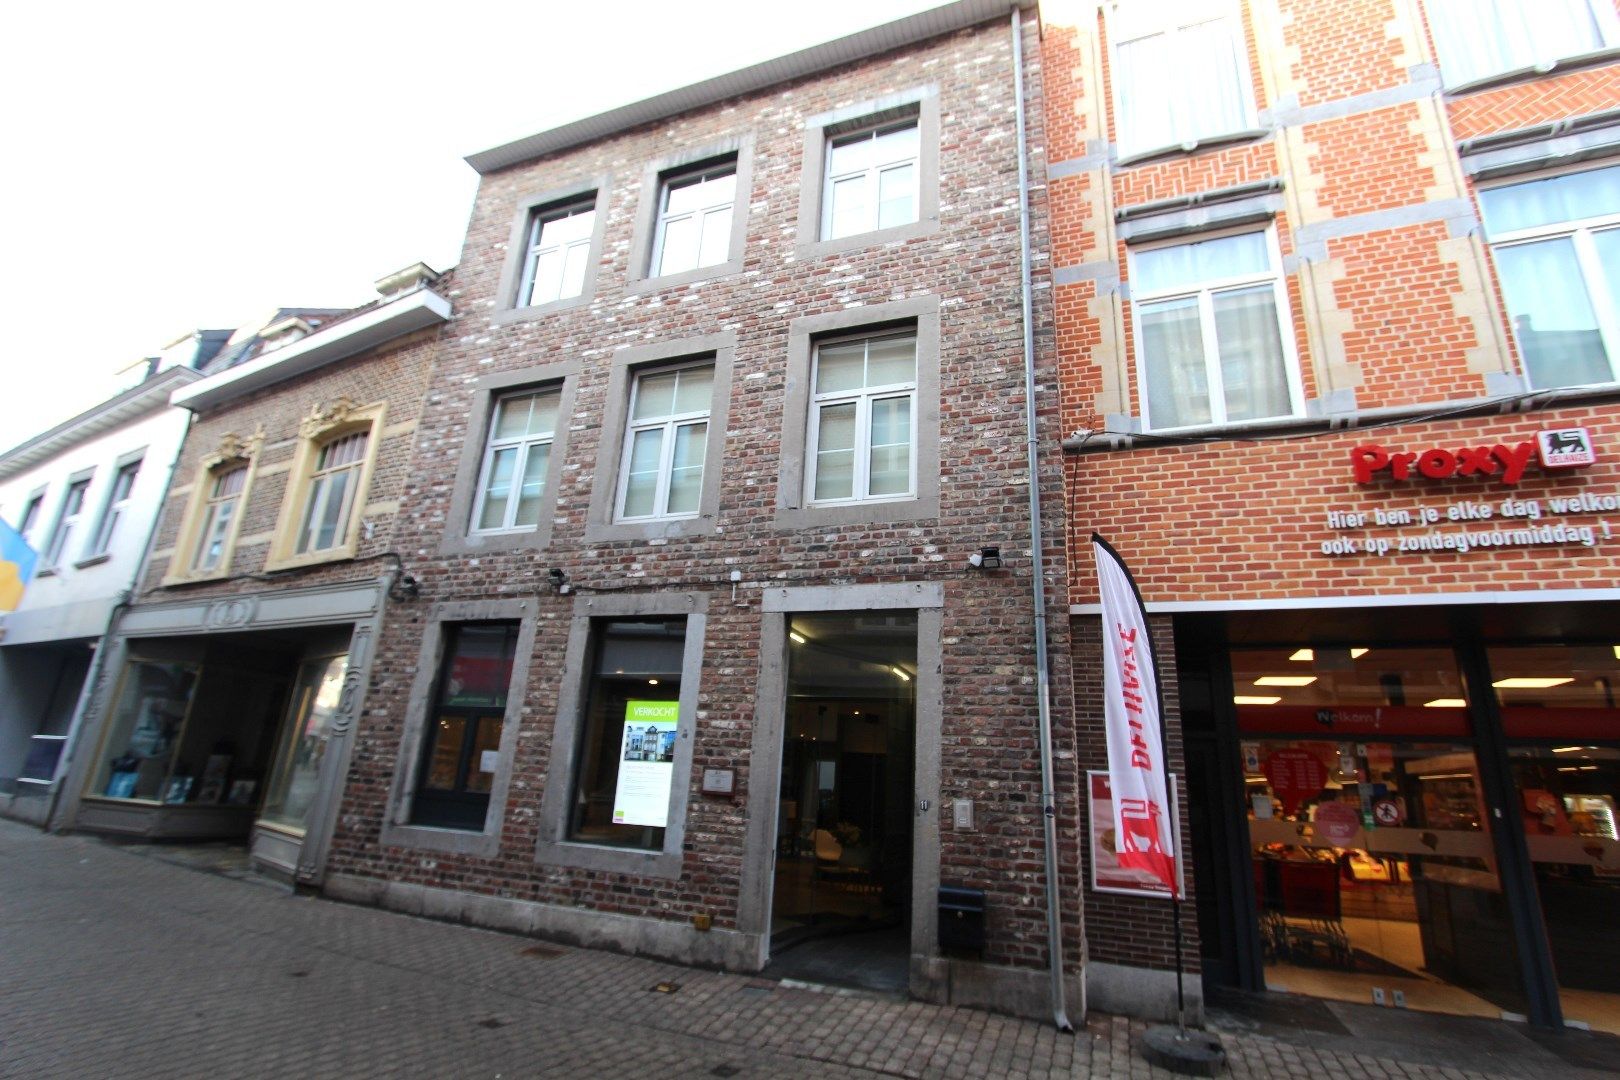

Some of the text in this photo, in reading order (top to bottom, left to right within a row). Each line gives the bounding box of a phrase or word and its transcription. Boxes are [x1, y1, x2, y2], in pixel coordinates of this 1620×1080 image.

[1351, 442, 1534, 485] Proxy
[1549, 453, 1589, 463] DELHAIZE
[1327, 510, 1366, 529] Hier
[1375, 508, 1410, 526] ben
[1419, 505, 1439, 527] je
[1448, 502, 1493, 521] elke
[1501, 499, 1541, 519] dag
[1321, 521, 1611, 556] ook op zondagvoormiddag !
[634, 707, 675, 717] VERKOCHT
[920, 800, 928, 810] 11
